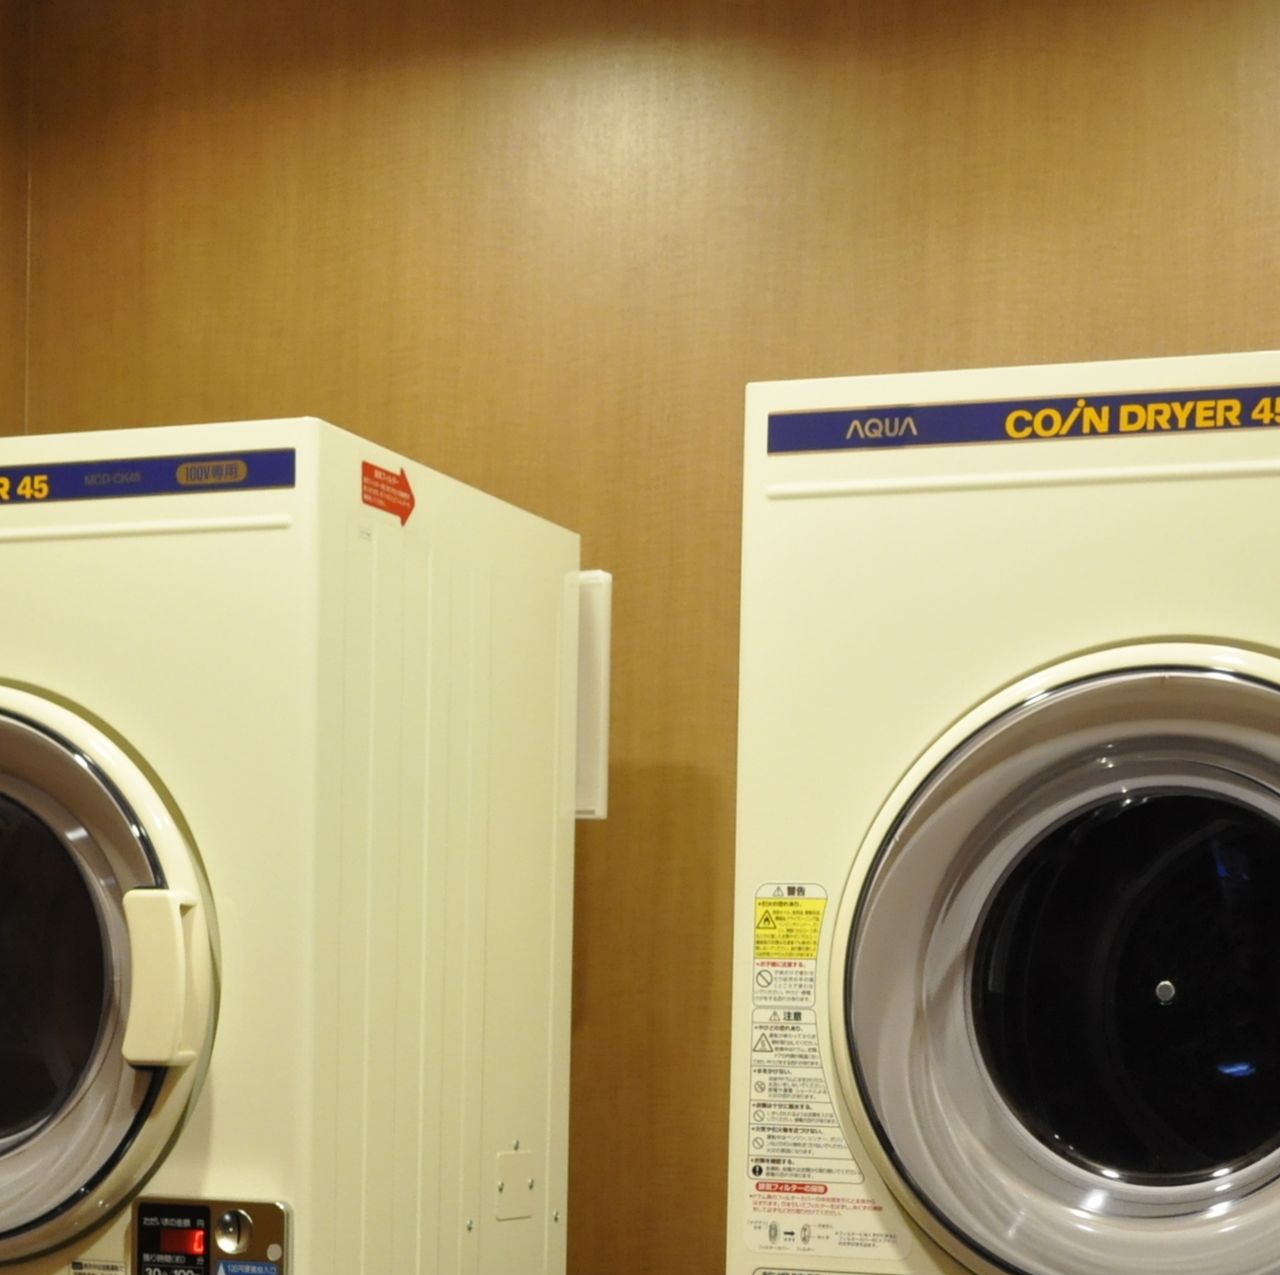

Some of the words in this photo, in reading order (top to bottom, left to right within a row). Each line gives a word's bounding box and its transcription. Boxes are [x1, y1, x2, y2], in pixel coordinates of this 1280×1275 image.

[1120, 399, 1241, 432] DRYER
[846, 416, 918, 440] AQUA
[16, 475, 50, 499] 45
